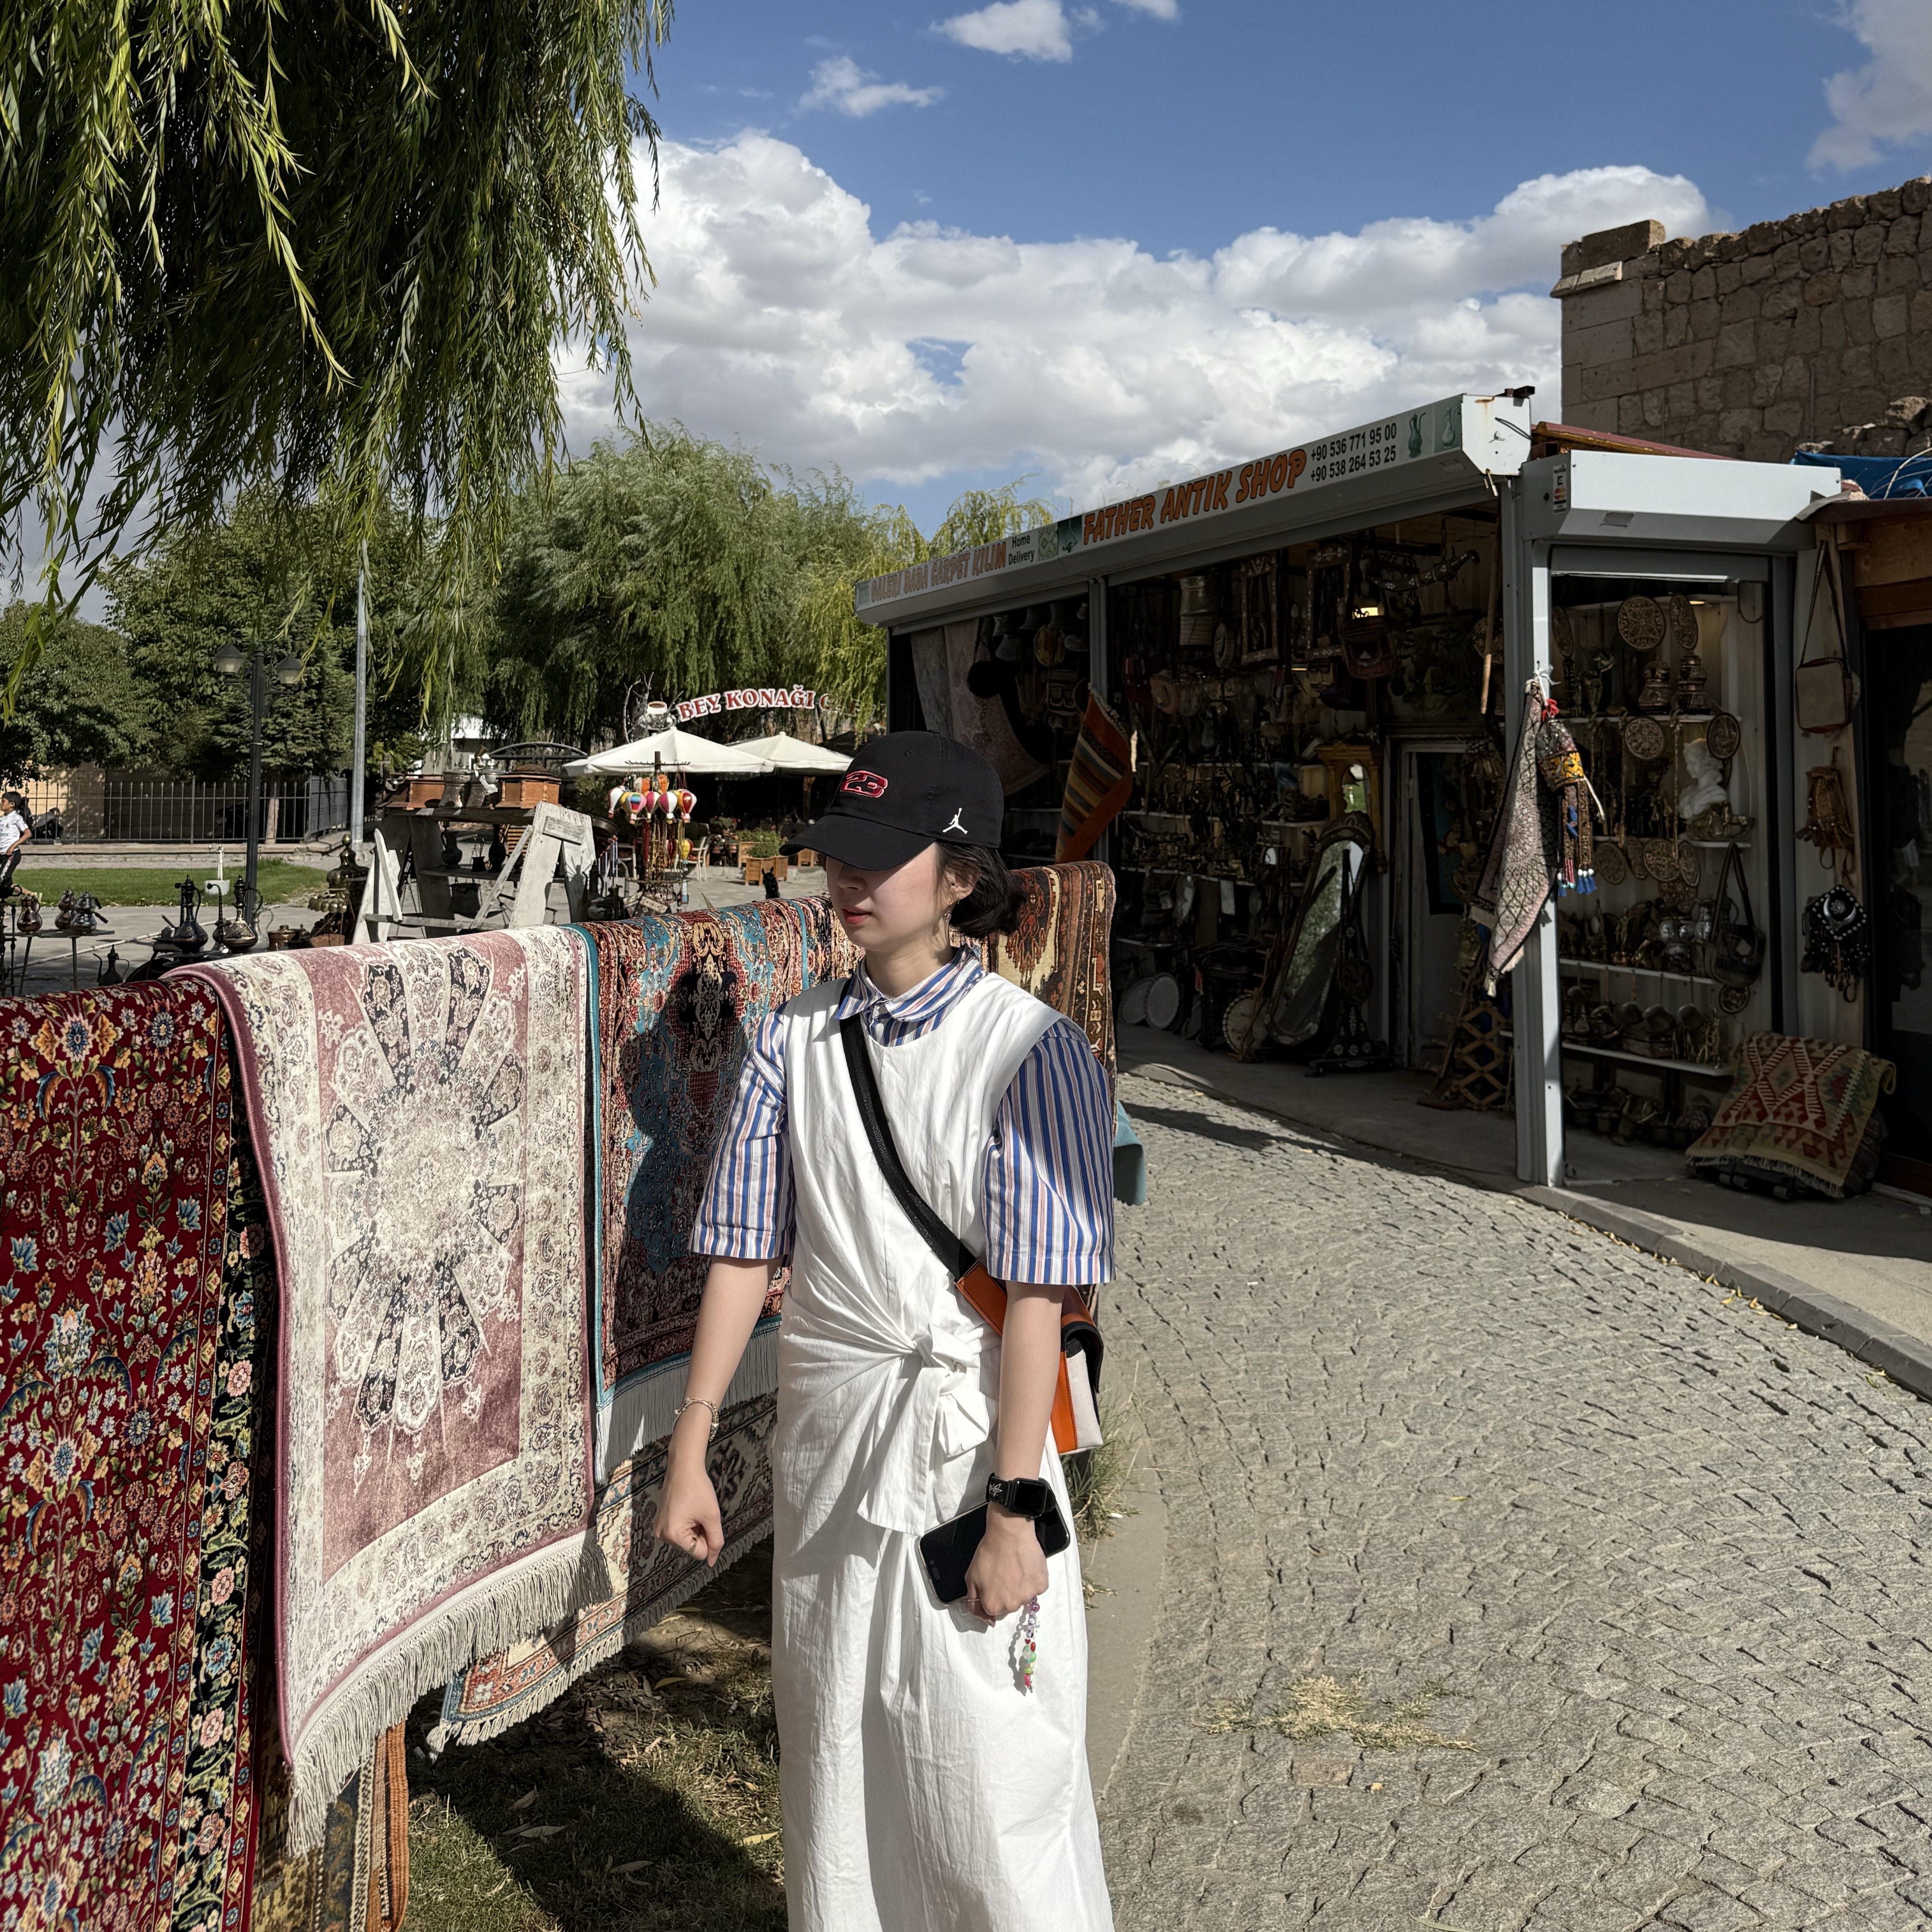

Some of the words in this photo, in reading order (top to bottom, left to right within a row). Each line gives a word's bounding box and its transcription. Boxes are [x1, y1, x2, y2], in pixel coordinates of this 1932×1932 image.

[1311, 444, 1327, 461] +90
[1330, 438, 1346, 457] 536
[1350, 432, 1365, 451] 771
[1369, 427, 1381, 445] 95
[1384, 423, 1397, 441] 00
[1311, 465, 1326, 482] +90
[1329, 460, 1346, 478] 538
[1349, 453, 1366, 473] 264
[1369, 449, 1380, 467] 53
[1383, 445, 1396, 463] 25
[1083, 495, 1156, 545] FATHER
[1160, 471, 1232, 523] ANTIK
[1236, 449, 1306, 503] SHOP
[1009, 550, 1035, 565] Delivery
[1012, 535, 1030, 548] Home
[904, 565, 928, 593] BABA
[931, 552, 970, 586] CARPET
[972, 541, 1006, 576] KILIM
[677, 693, 721, 722] BEY
[724, 684, 816, 710] KONAĞI
